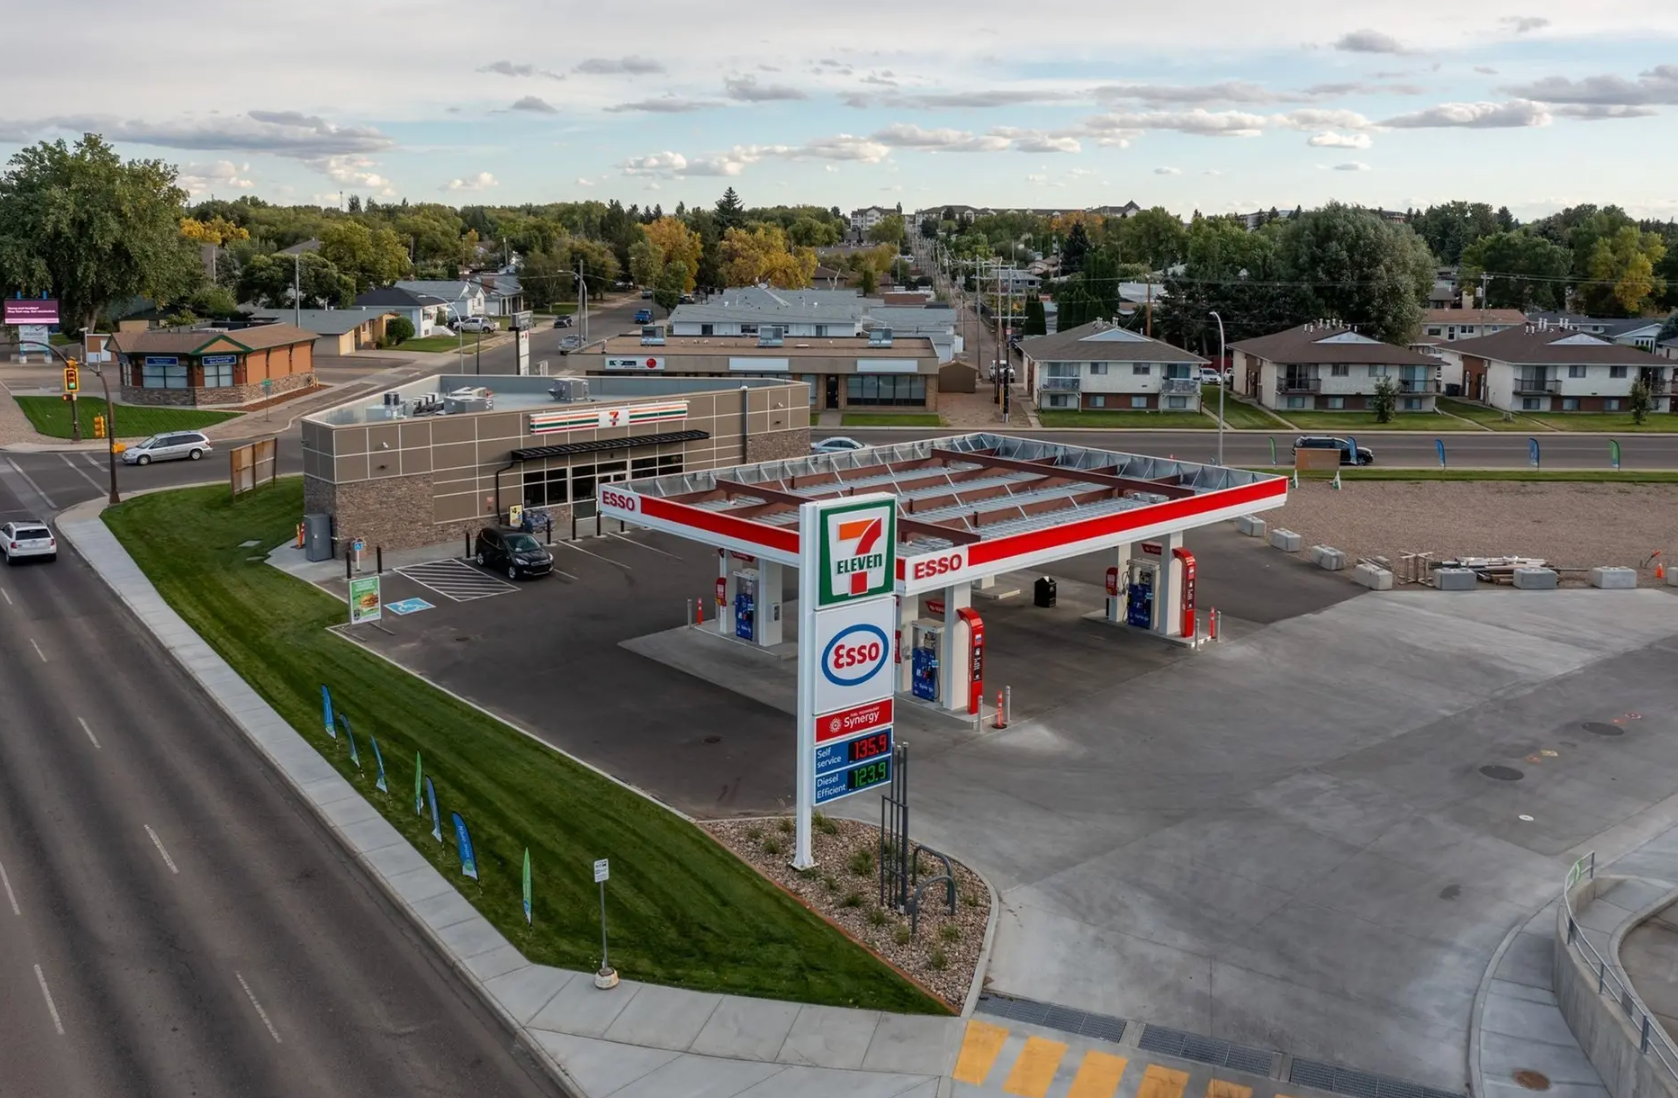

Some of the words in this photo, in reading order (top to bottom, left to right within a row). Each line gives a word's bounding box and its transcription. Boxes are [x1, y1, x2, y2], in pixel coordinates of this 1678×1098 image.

[602, 491, 635, 511] ESSO
[839, 517, 882, 594] 7
[913, 553, 963, 580] ESSO
[844, 711, 880, 729] Synergy
[817, 747, 831, 759] Self
[854, 734, 887, 760] 135.9
[817, 756, 842, 769] service
[817, 774, 839, 788] Diesel
[854, 762, 886, 787] 123.9
[817, 785, 846, 799] Efficient
